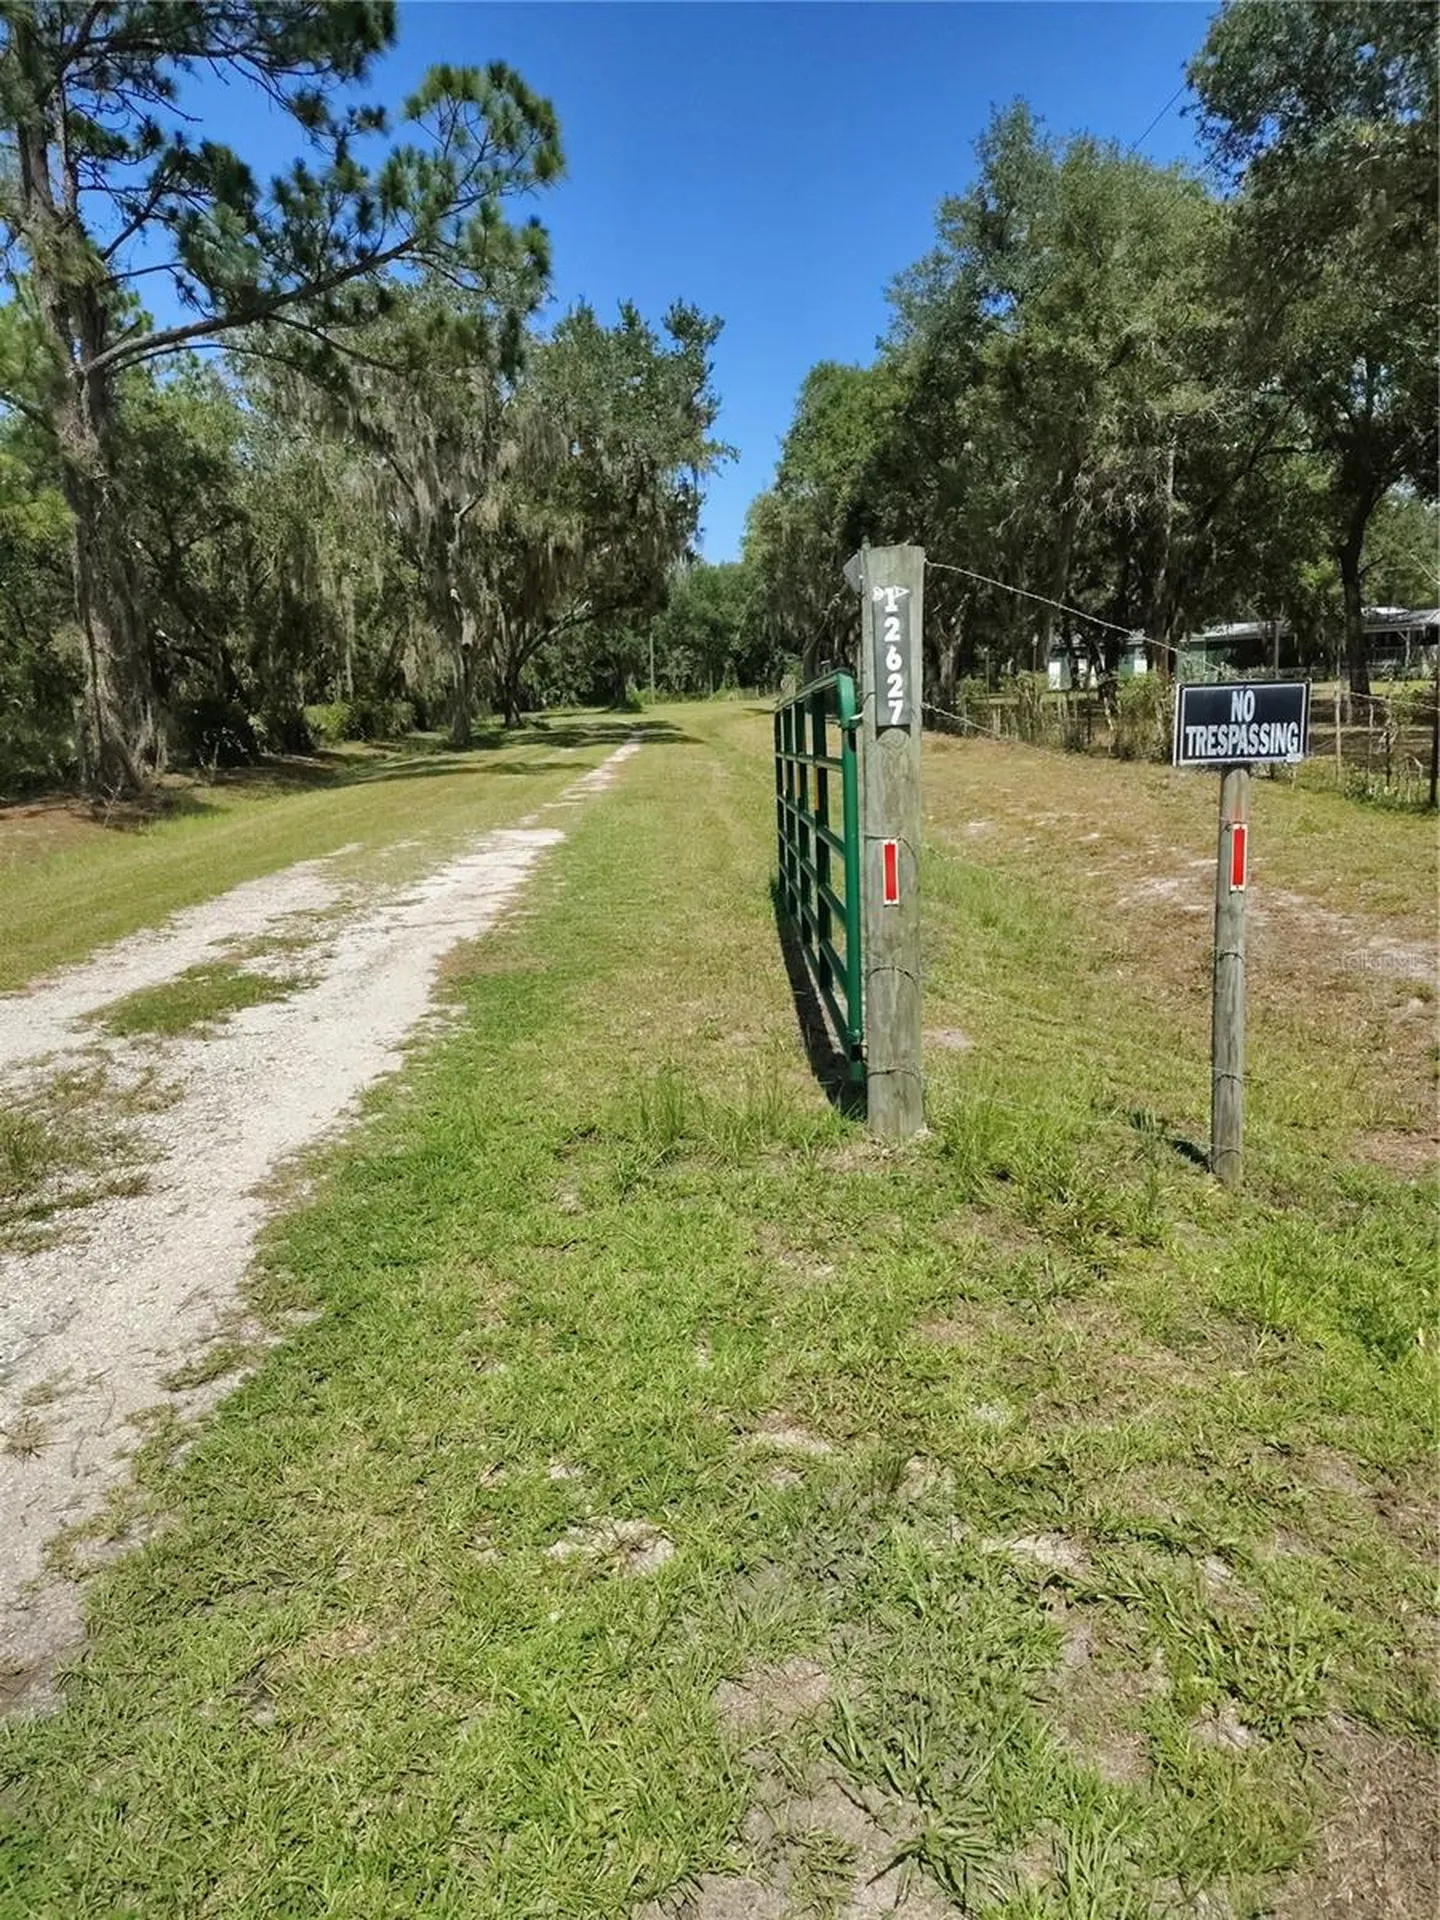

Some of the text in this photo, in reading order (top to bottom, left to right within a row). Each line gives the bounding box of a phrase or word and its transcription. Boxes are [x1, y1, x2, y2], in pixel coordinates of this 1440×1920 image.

[884, 586, 904, 725] 12627
[1230, 690, 1256, 722] NO
[1185, 721, 1299, 756] TRESPASSING
